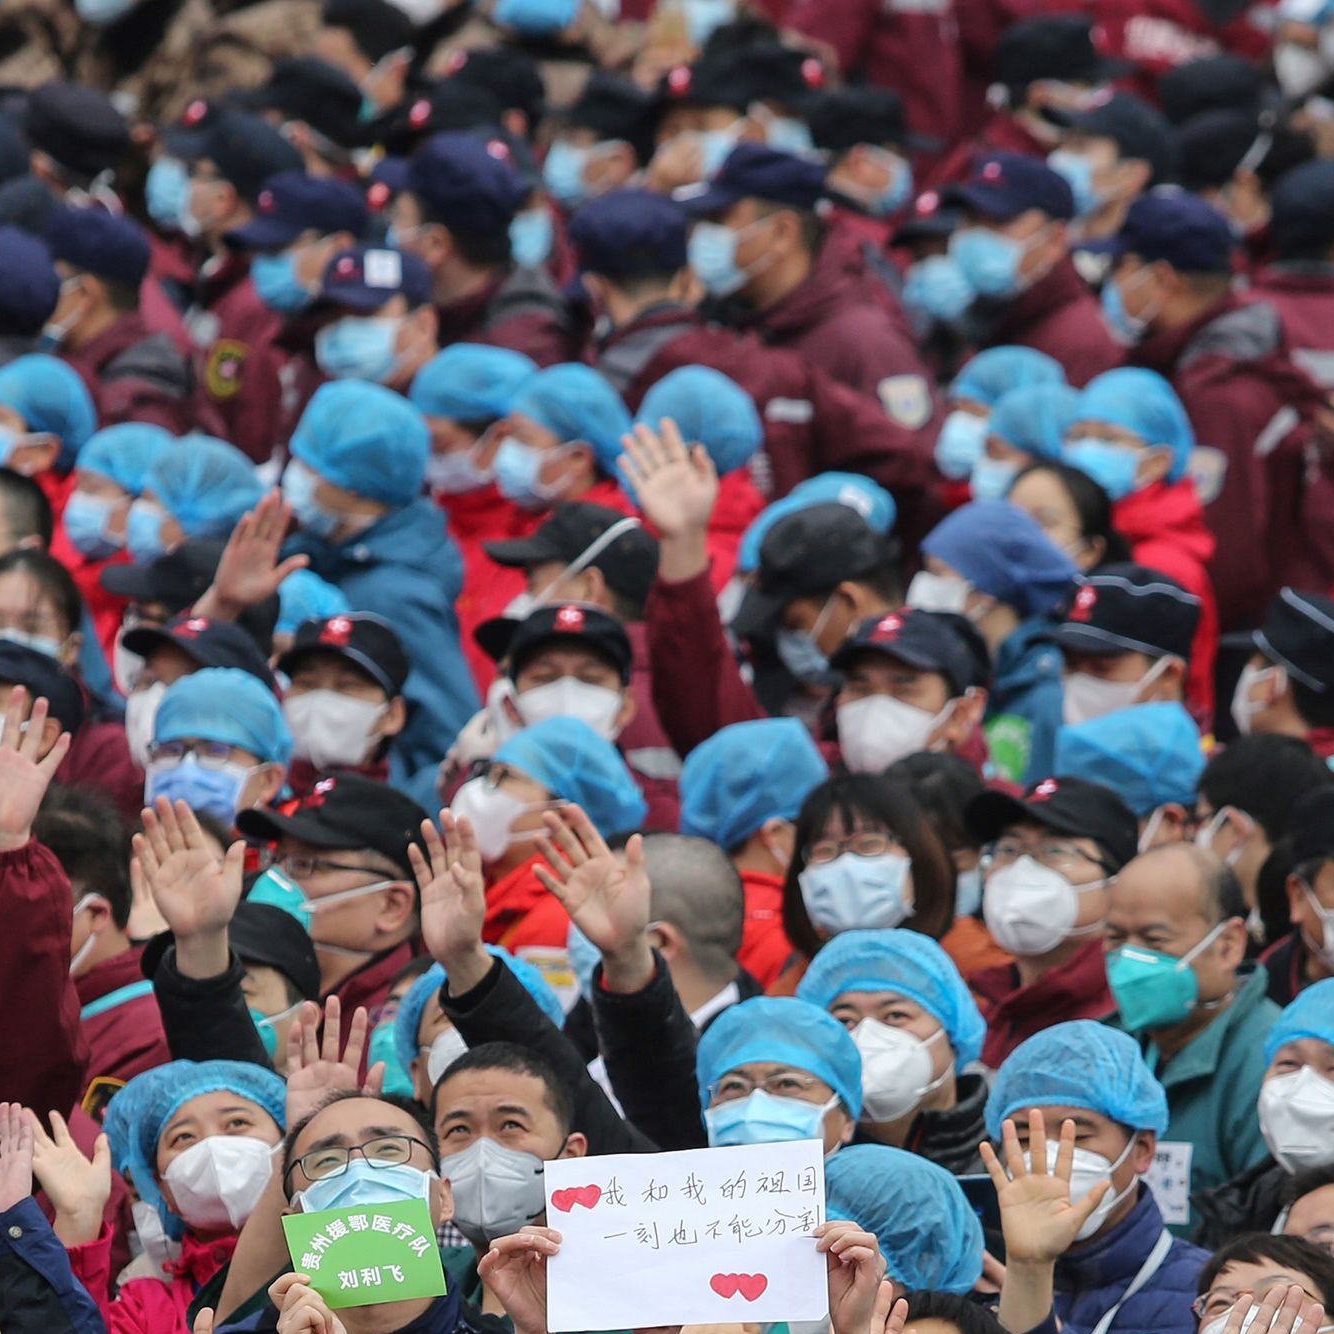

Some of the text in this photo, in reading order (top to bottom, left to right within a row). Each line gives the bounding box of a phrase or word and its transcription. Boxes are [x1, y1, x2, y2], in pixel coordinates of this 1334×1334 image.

[602, 1166, 817, 1207] 我和我的祖国
[301, 1214, 431, 1270] 贵州援鄂医疗队
[604, 1205, 820, 1249] 一刻也不能分割
[338, 1265, 405, 1290] 刘利飞
